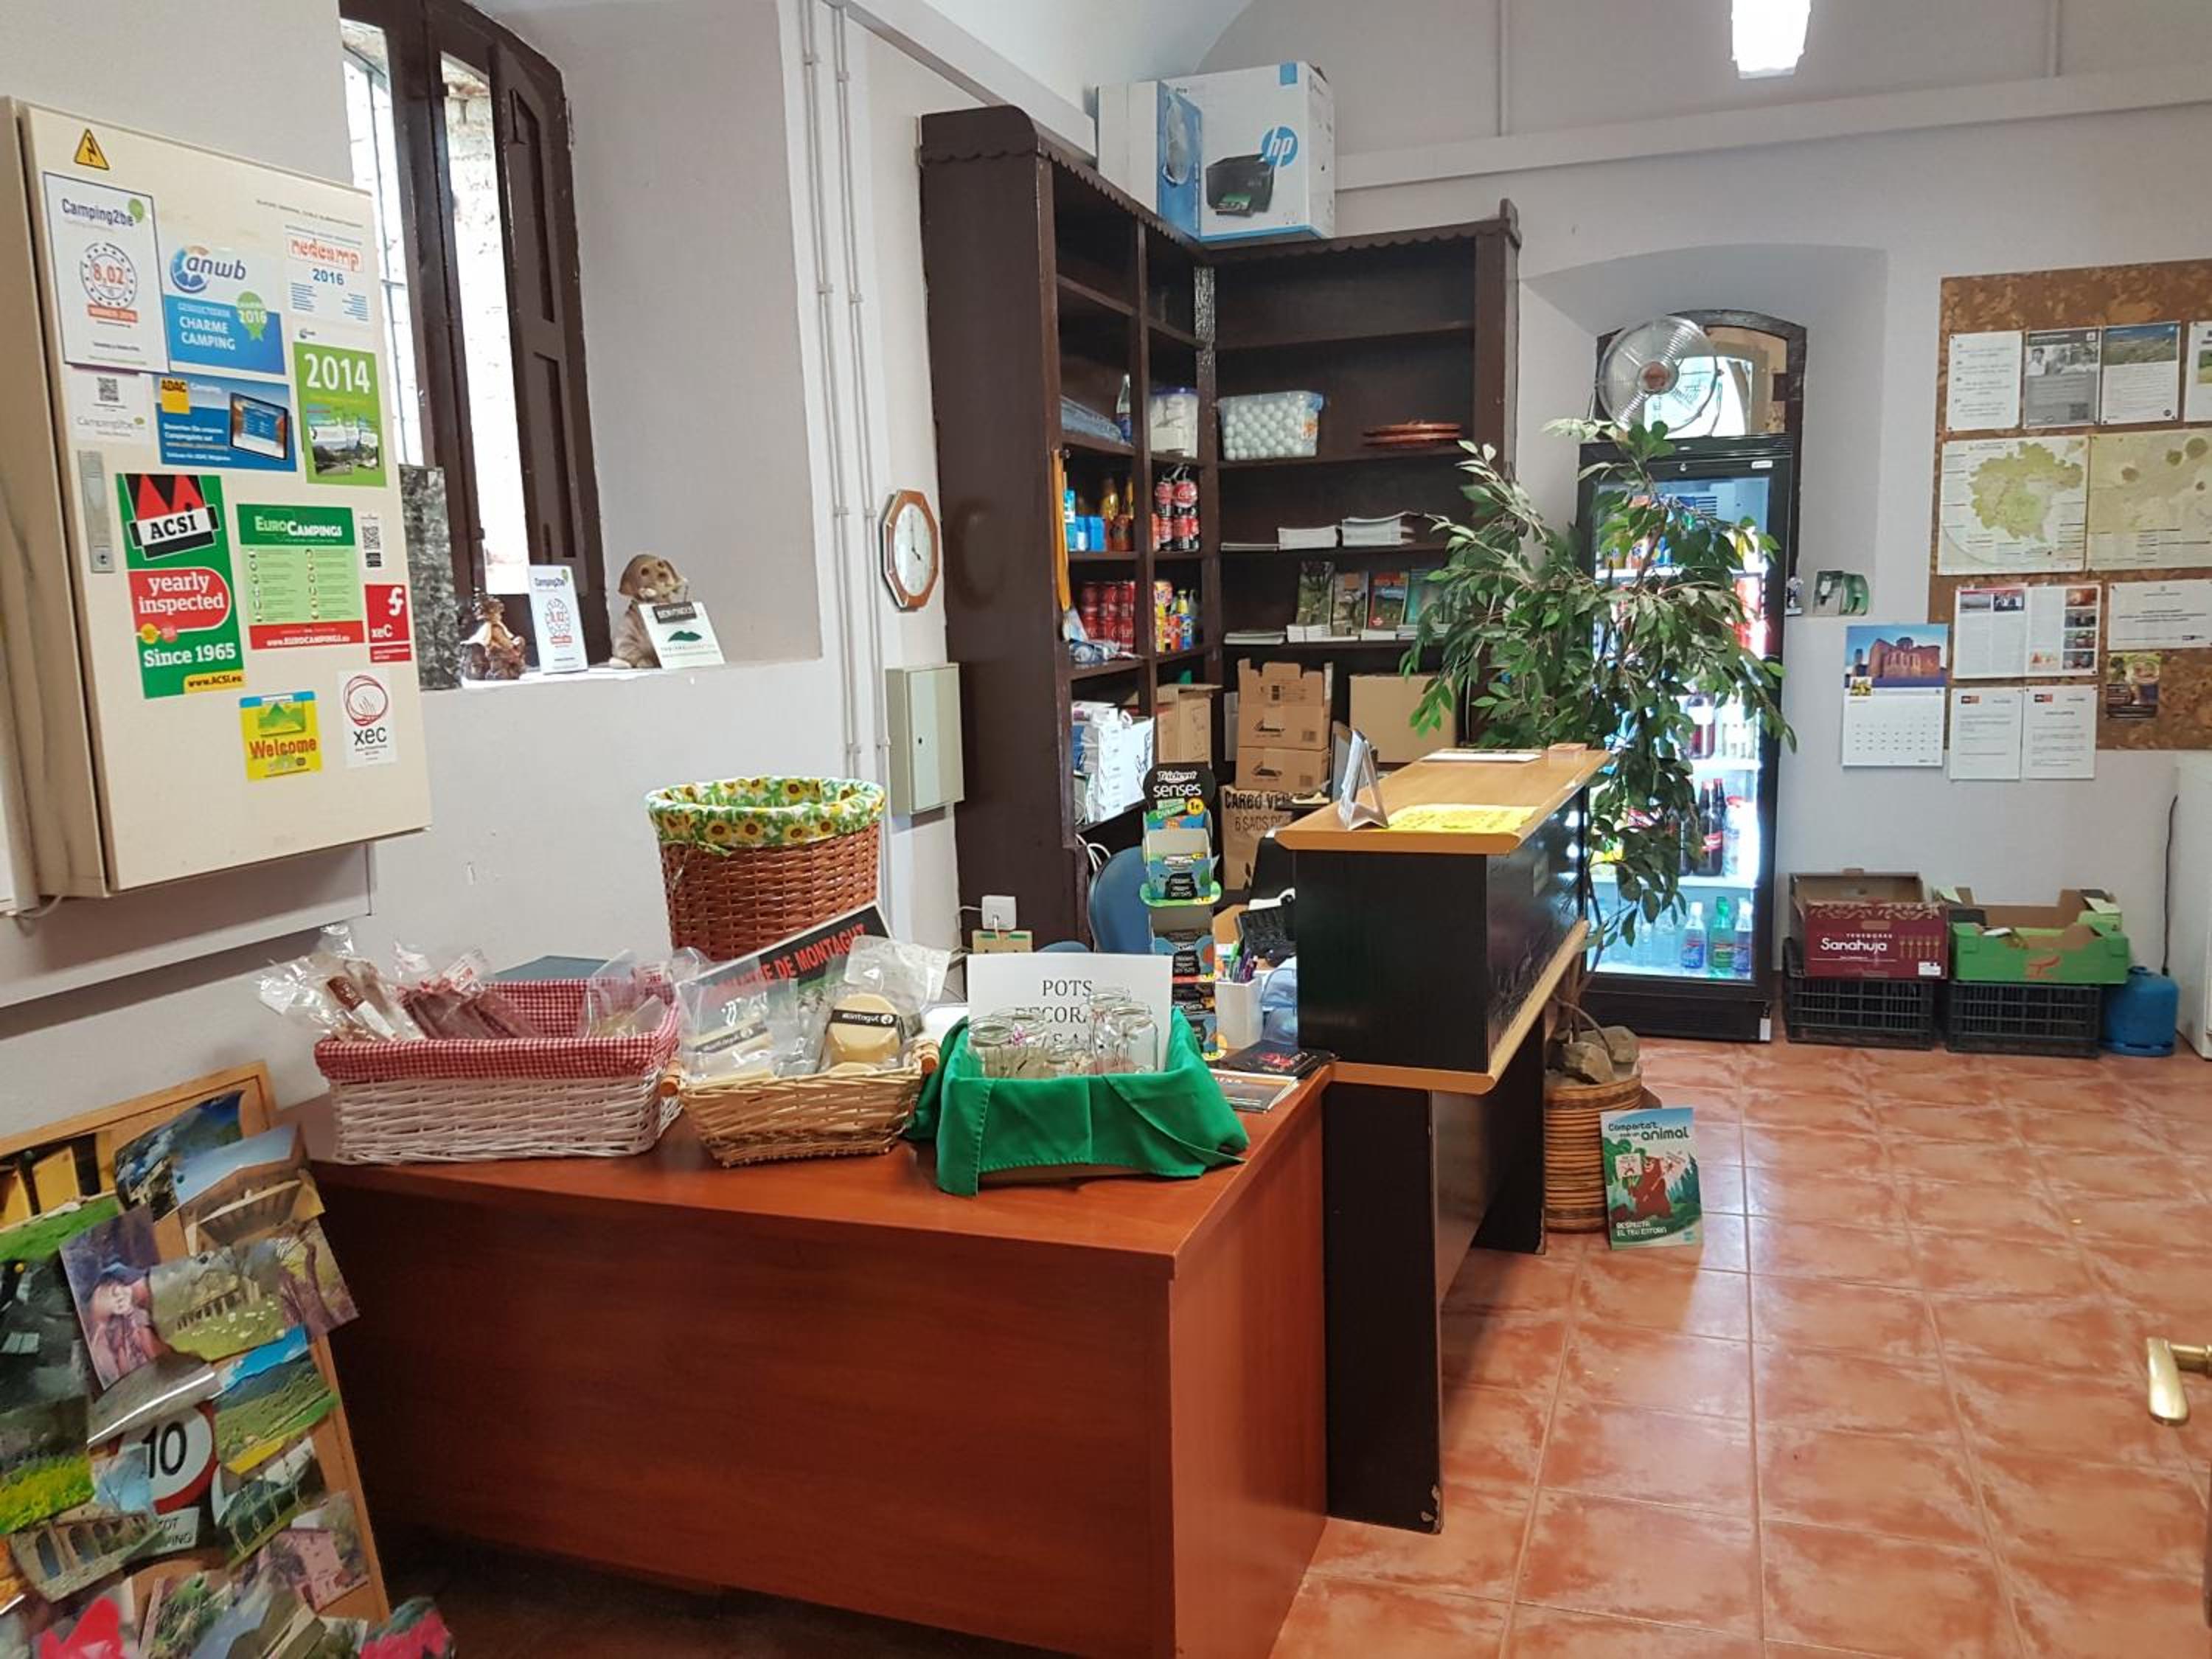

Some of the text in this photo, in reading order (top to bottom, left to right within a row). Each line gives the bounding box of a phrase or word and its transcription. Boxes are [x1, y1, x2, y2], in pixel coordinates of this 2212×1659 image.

[187, 257, 246, 280] anwb
[312, 268, 344, 285] 2016
[179, 316, 229, 334] CHARME
[181, 332, 236, 350] CAMPING
[305, 353, 371, 394] 2014
[161, 380, 187, 392] ADAC
[147, 571, 210, 597] yearly
[139, 592, 225, 616] inspected
[143, 642, 236, 668] Since 1965
[353, 727, 387, 746] xec
[249, 738, 317, 760] Welcome
[1152, 784, 1203, 797] senses
[1225, 791, 1262, 810] CARBO
[1820, 937, 1888, 955] Sanahuja
[775, 955, 797, 979] DE
[1043, 979, 1093, 996] POTS
[1641, 1126, 1690, 1141] animal
[142, 1422, 187, 1479] 10
